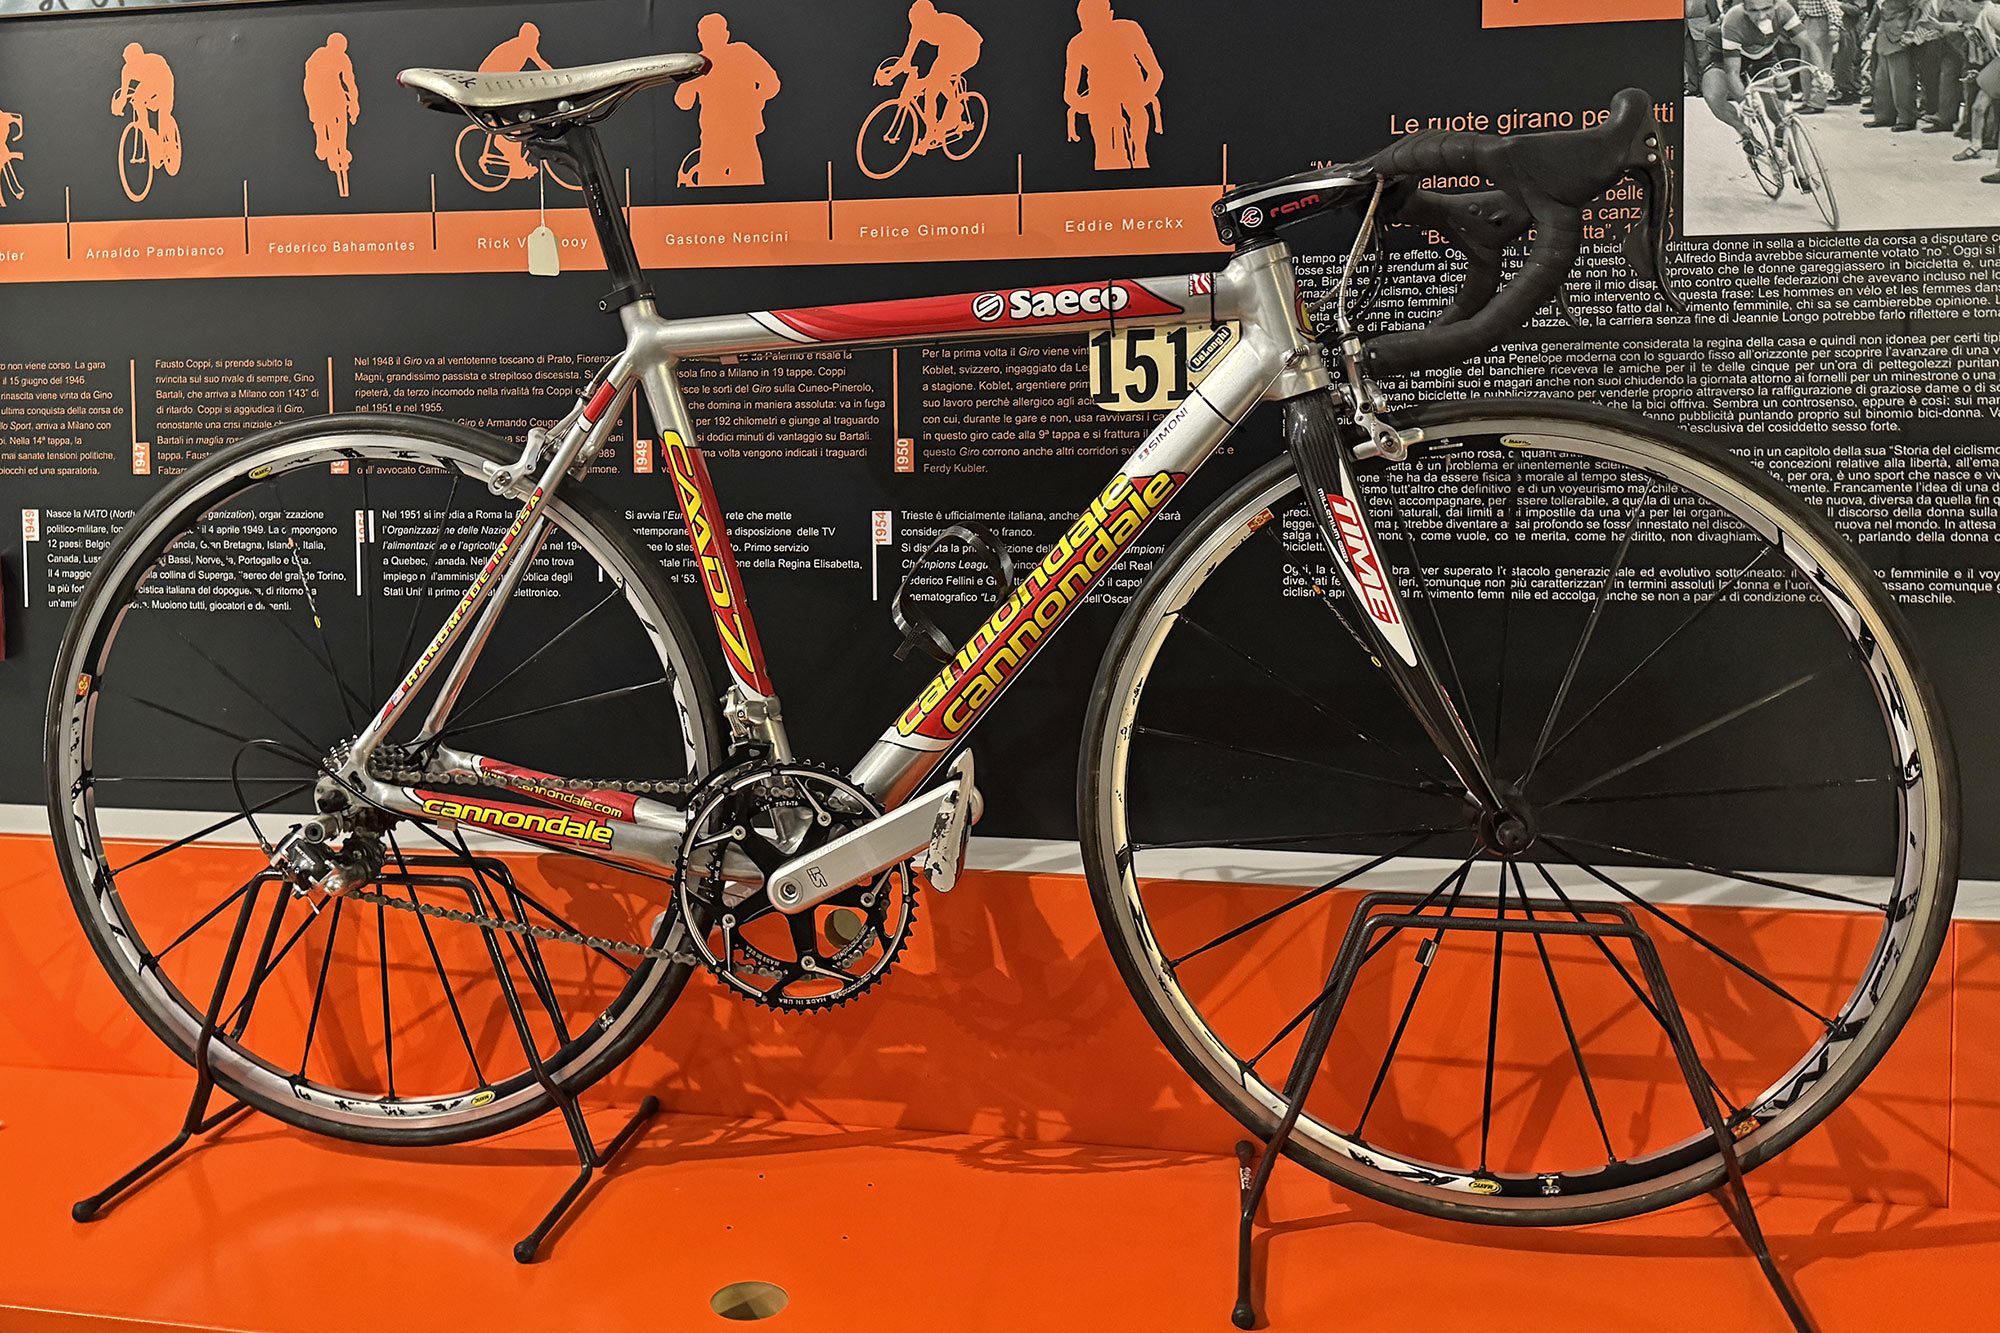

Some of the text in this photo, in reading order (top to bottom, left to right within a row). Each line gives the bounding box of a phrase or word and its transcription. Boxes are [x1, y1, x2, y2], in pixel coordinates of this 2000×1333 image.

[1391, 115, 1419, 134] Le
[1428, 112, 1489, 131] ruote
[1497, 109, 1573, 135] girano
[1583, 109, 1611, 130] pe
[1598, 207, 1642, 220] canz
[859, 222, 985, 238] Felice Gimondi
[1065, 217, 1183, 233] Eddie Merckx
[477, 237, 510, 249] Rick
[665, 230, 788, 245] Gastone Nencini
[1712, 239, 1749, 250] donne
[1752, 238, 1762, 248] in
[1766, 238, 1793, 249] sella
[1808, 236, 1860, 248] biciclette
[1863, 235, 1879, 245] da
[1882, 237, 1916, 246] corsa
[1919, 236, 1927, 245] a
[1931, 232, 1988, 247] disputare
[86, 246, 224, 259] Arnaldo Pambianco
[268, 240, 415, 254] Federico Bahamontes
[1678, 290, 1717, 301] questa
[1758, 287, 1779, 297] Les
[1783, 286, 1834, 297] hommes
[1837, 287, 1852, 296] en
[1856, 285, 1882, 296] vélo
[1885, 285, 1897, 295] et
[1900, 284, 1918, 295] les
[1922, 282, 1971, 295] femmes
[1009, 286, 1129, 321] Saeco
[922, 346, 1069, 359] Per la prima volta il Giro viene
[354, 357, 369, 365] Nel
[372, 356, 393, 365] 1948
[403, 356, 422, 365] Giro
[437, 356, 445, 364] al
[447, 356, 497, 364] ventotenne
[499, 356, 534, 364] toscano
[536, 355, 544, 363] di
[1091, 327, 1194, 404] 151
[386, 372, 440, 383] grandissimo
[442, 372, 478, 381] passista
[489, 371, 532, 381] strepitoso
[584, 370, 594, 379] Si
[699, 368, 717, 377] fino
[727, 368, 758, 377] Milano
[760, 368, 769, 376] in
[772, 367, 783, 376] 19
[818, 366, 845, 377] Coppi
[695, 418, 711, 426] per
[714, 416, 730, 425] 192
[733, 416, 777, 425] chilometri
[788, 416, 820, 426] giunge
[822, 416, 831, 424] al
[833, 415, 879, 426] traguardo
[1746, 422, 1764, 432] del
[1767, 420, 1828, 432] cosiddetto
[1831, 423, 1866, 431] sesso
[1149, 407, 1189, 451] SIMONI
[135, 444, 147, 474] 1947
[636, 441, 648, 473] 1949
[897, 439, 909, 472] 1950
[923, 463, 951, 474] Ferdy
[46, 509, 108, 517] Nasce la NATO
[382, 510, 431, 518] Nel 1951 si
[746, 511, 763, 519] che
[765, 511, 792, 519] mette
[900, 510, 933, 519] Trieste
[944, 511, 1005, 519] ufficialmente
[1048, 511, 1079, 520] anche
[1827, 506, 1997, 517] Il discorso della donna sulla
[25, 510, 36, 540] 1949
[208, 525, 214, 533] 4
[216, 525, 240, 535] aprile
[876, 511, 887, 544] 1954
[238, 555, 281, 566] Portogallo
[753, 559, 775, 567] della
[778, 559, 810, 570] Regina
[1129, 561, 1152, 570] Real
[1331, 498, 1399, 624] TIME
[551, 572, 572, 583] degli
[946, 575, 974, 585] Fellini
[405, 493, 541, 687] HANDMADE IN USA
[151, 600, 187, 609] Muoiono
[209, 601, 245, 611] giocatori
[943, 471, 1175, 733] cannondale
[423, 799, 613, 843] cannondale
